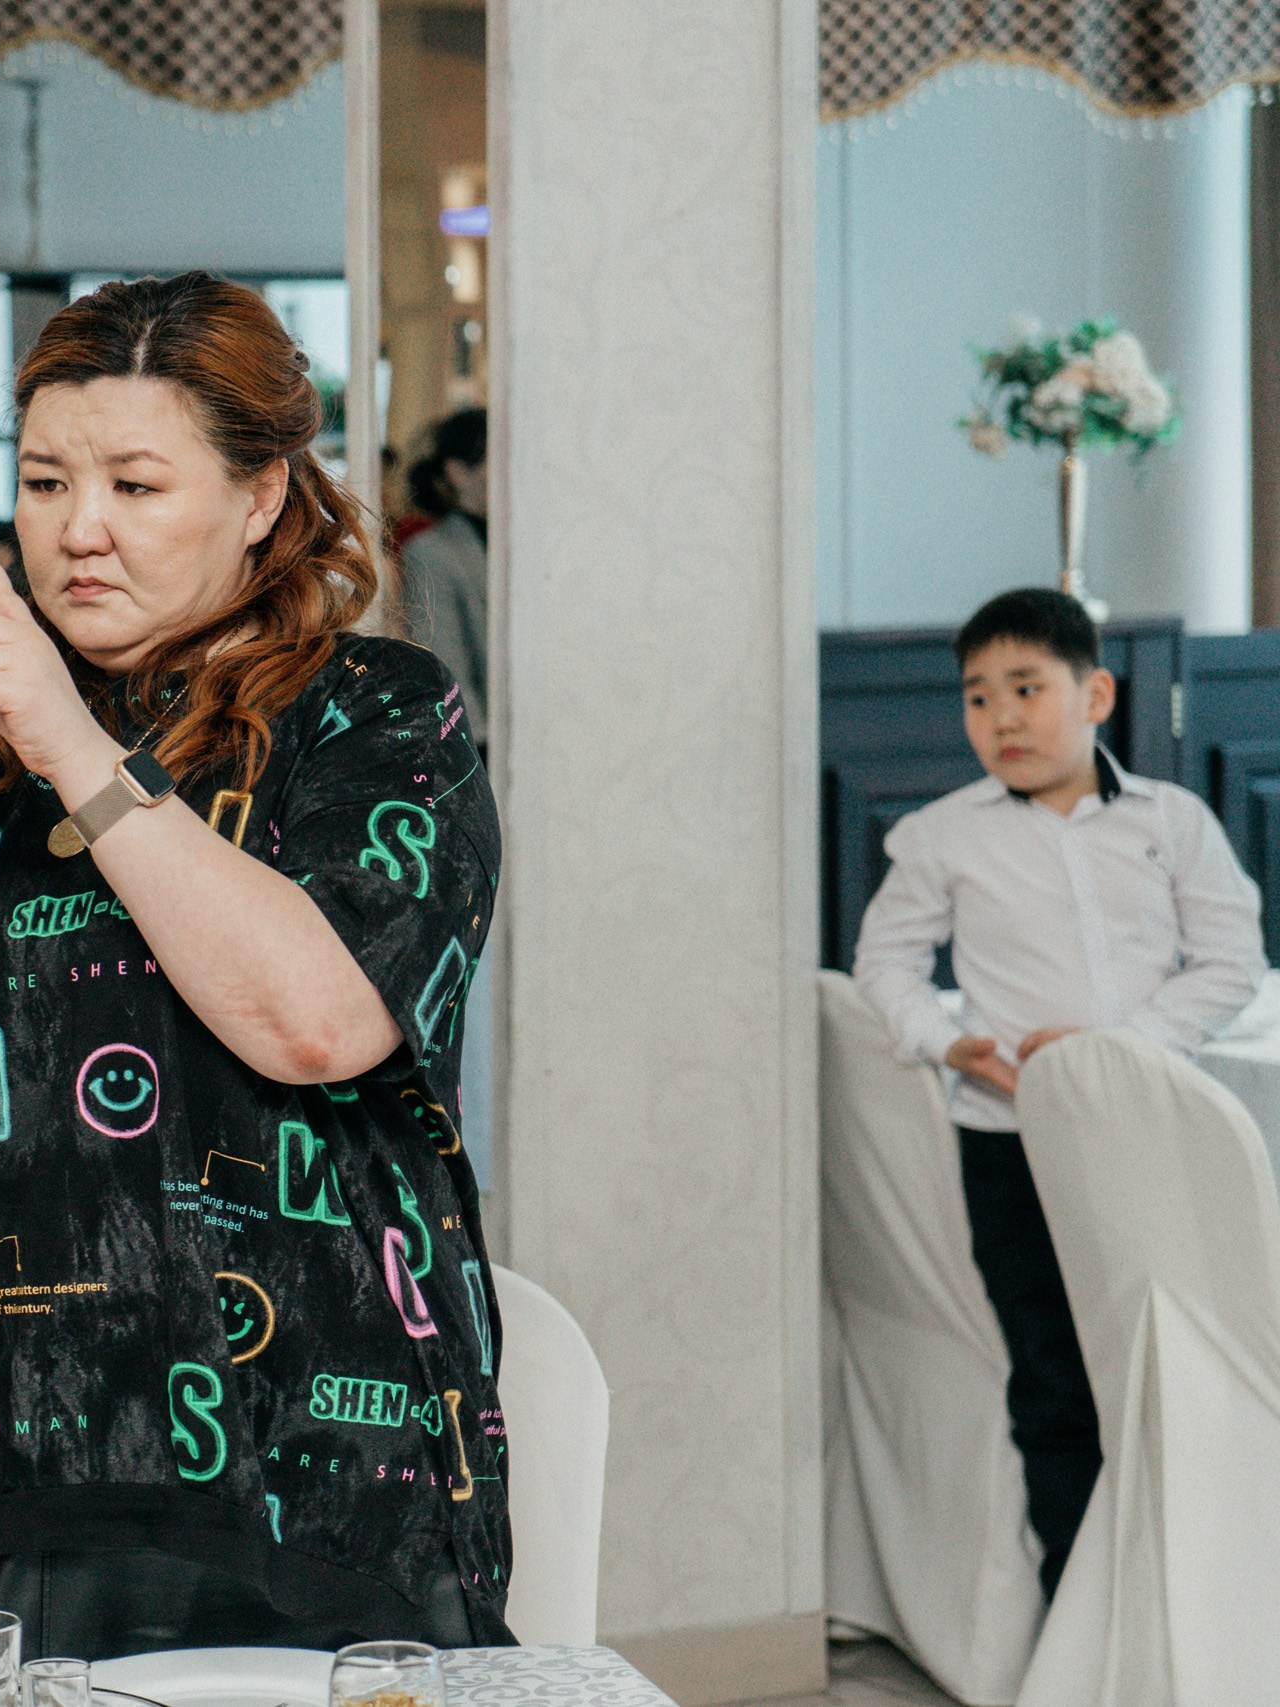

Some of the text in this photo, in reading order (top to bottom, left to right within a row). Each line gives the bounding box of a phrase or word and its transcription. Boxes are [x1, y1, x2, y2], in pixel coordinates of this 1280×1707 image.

[71, 960, 157, 982] SHEN
[225, 1202, 247, 1215] and
[249, 1206, 269, 1220] has
[441, 1215, 462, 1230] WE
[53, 1282, 108, 1294] designers
[168, 1362, 227, 1482] S
[267, 1446, 340, 1474] ARE
